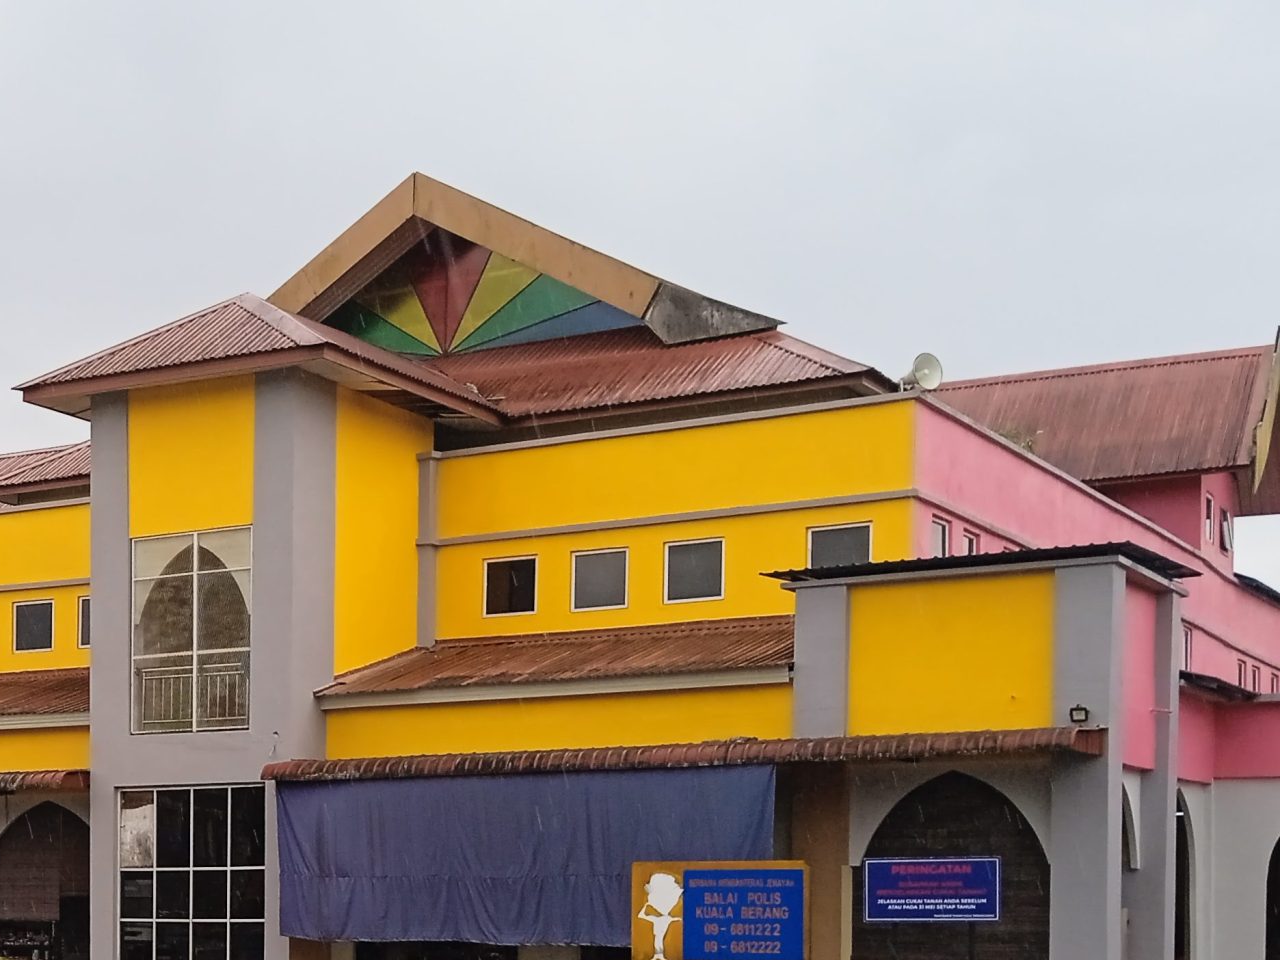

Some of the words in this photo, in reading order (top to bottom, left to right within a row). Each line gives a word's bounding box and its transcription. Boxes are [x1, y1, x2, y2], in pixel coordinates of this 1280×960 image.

[891, 864, 972, 874] PERINGATAN
[704, 892, 738, 904] BALAI
[748, 892, 782, 905] POLIS
[695, 906, 734, 918] KUALA
[741, 906, 790, 919] BERANG
